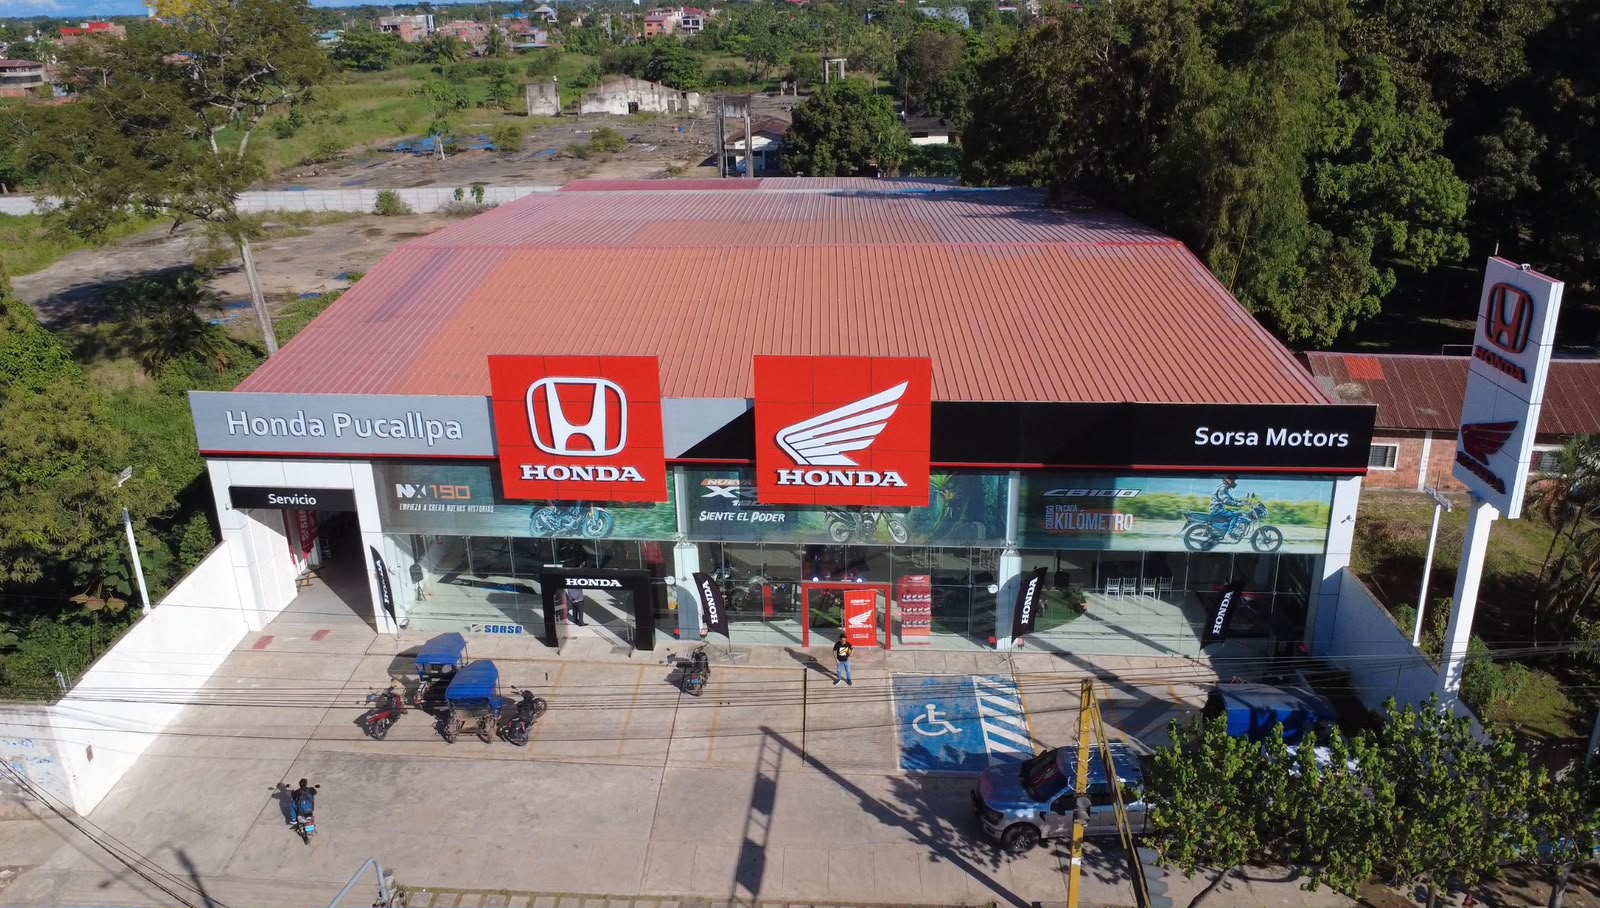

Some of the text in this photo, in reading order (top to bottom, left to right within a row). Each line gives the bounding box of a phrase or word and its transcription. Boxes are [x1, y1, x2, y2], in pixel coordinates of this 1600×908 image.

[1474, 345, 1527, 383] HONDA
[226, 409, 463, 446] Honda Pucallpa
[1194, 427, 1349, 447] Sorsa Motors
[520, 464, 645, 482] HONDA
[776, 469, 908, 487] HONDA
[268, 491, 317, 507] Servicio
[395, 483, 471, 499] NX 190
[1043, 489, 1141, 497] CB100
[400, 503, 421, 511] EMPIEZA
[429, 504, 445, 512] CREAR
[468, 505, 494, 513] HISTORIAS
[699, 510, 785, 523] SIENTE EL PODER
[1055, 509, 1134, 531] KILÓMETRO
[565, 577, 622, 588] HONDA
[702, 579, 718, 625] HONDA
[1021, 576, 1038, 625] HONDA
[1212, 591, 1234, 635] HONDA
[484, 624, 523, 634] SORSA
